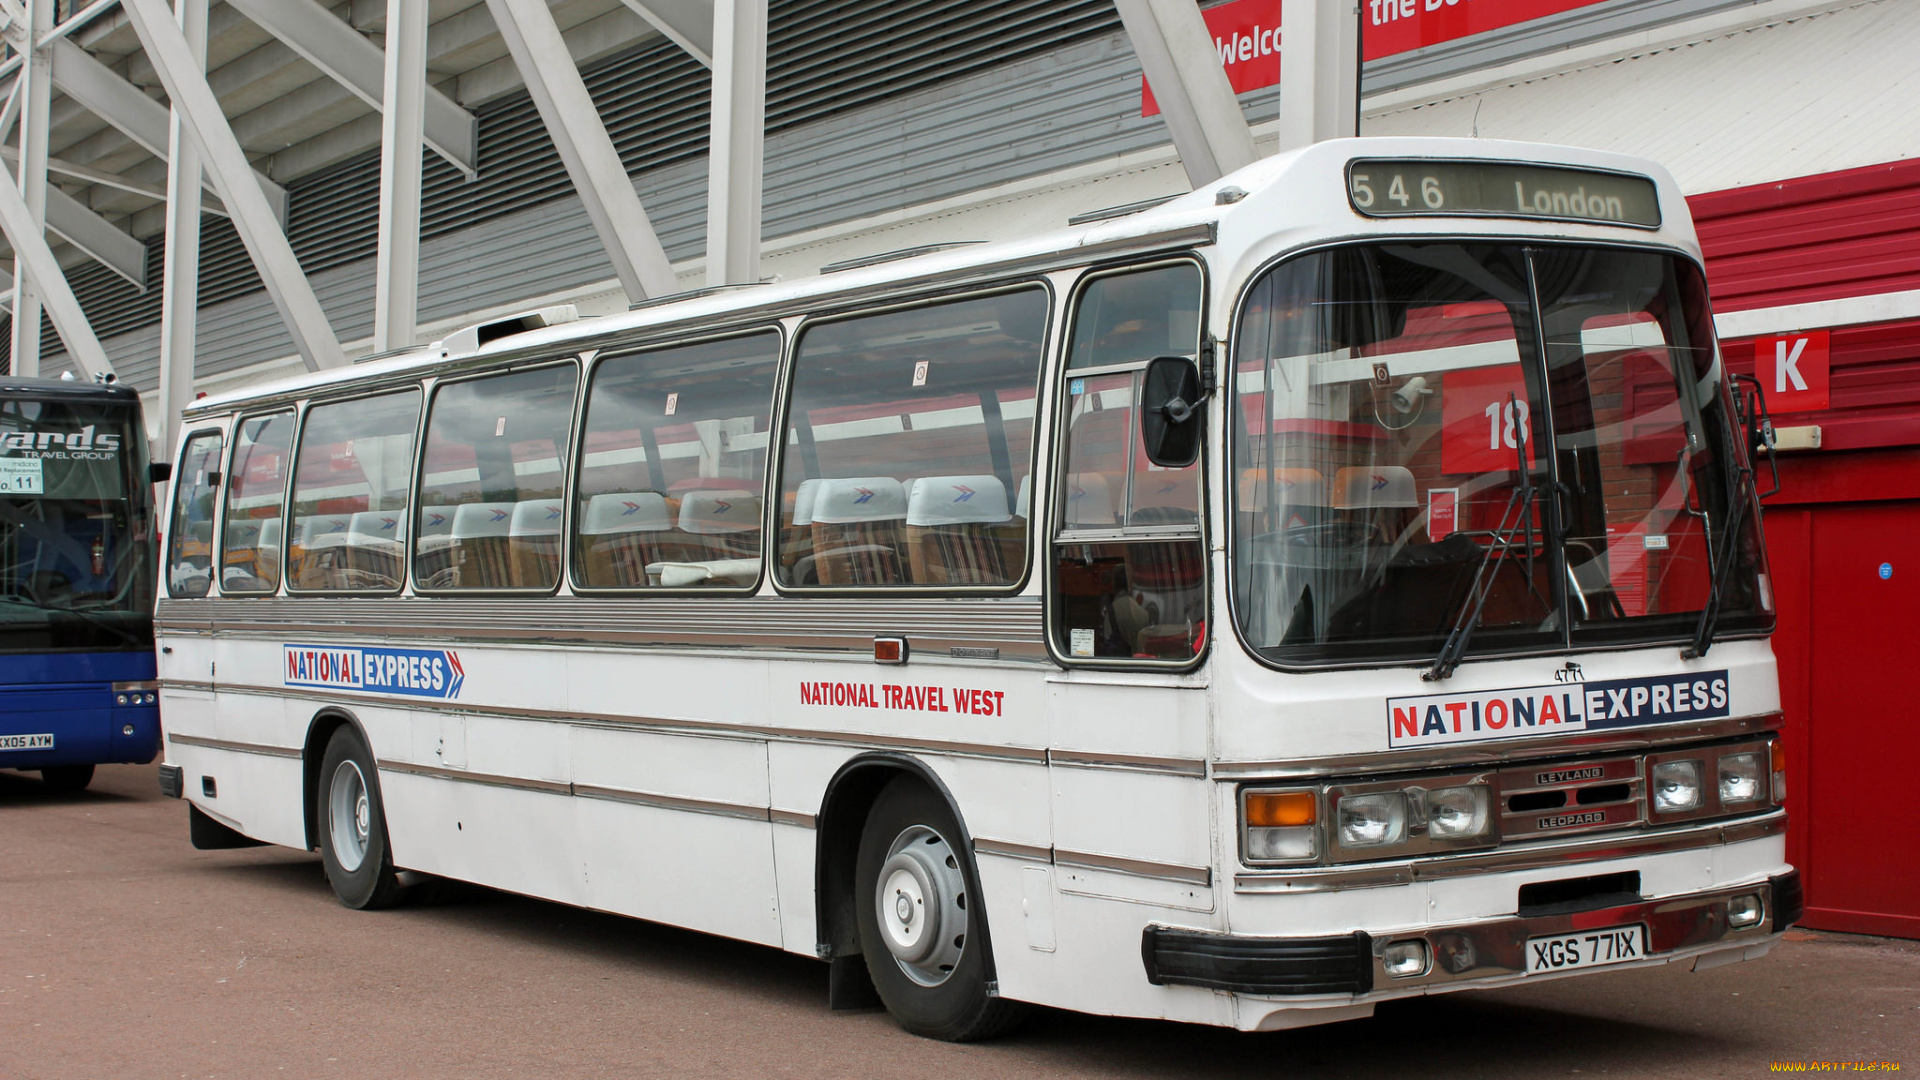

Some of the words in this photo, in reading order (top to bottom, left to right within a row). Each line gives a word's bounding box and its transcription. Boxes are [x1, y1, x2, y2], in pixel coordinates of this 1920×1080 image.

[1515, 181, 1624, 219] London
[1775, 338, 1809, 393] K
[1485, 399, 1530, 450] 18
[21, 451, 70, 460] TRAVEL
[71, 452, 115, 460] GROUP
[16, 476, 32, 489] 11
[288, 650, 360, 684] NATIONAL
[364, 653, 444, 691] EXPRESS
[1554, 667, 1586, 682] 4771
[800, 681, 879, 708] NATIONAL
[882, 684, 949, 713] TRAVEL
[952, 687, 1004, 717] WEST
[1393, 693, 1582, 739] NATIONAL
[1585, 678, 1728, 722] EXPRESS
[29, 735, 52, 747] AYM
[1540, 768, 1602, 783] LEYLAND
[1541, 812, 1603, 828] LEOPARD
[1533, 938, 1580, 970] XGS
[1585, 930, 1636, 962] 771X
